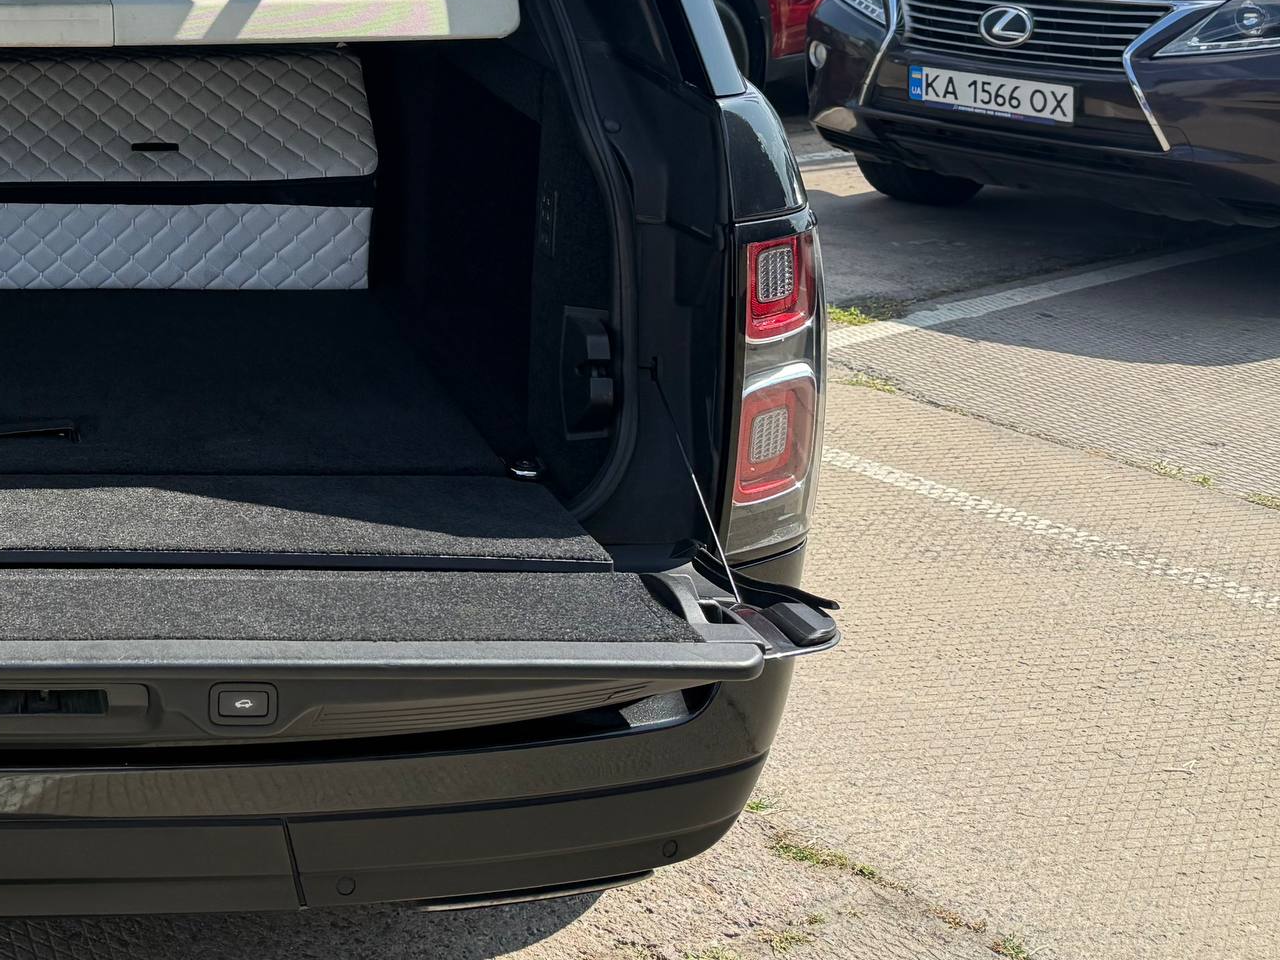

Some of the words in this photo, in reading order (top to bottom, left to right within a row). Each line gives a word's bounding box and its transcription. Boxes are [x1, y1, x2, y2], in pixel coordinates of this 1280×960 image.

[925, 73, 958, 100] KA
[968, 80, 1021, 109] 1566
[1030, 89, 1068, 117] OX
